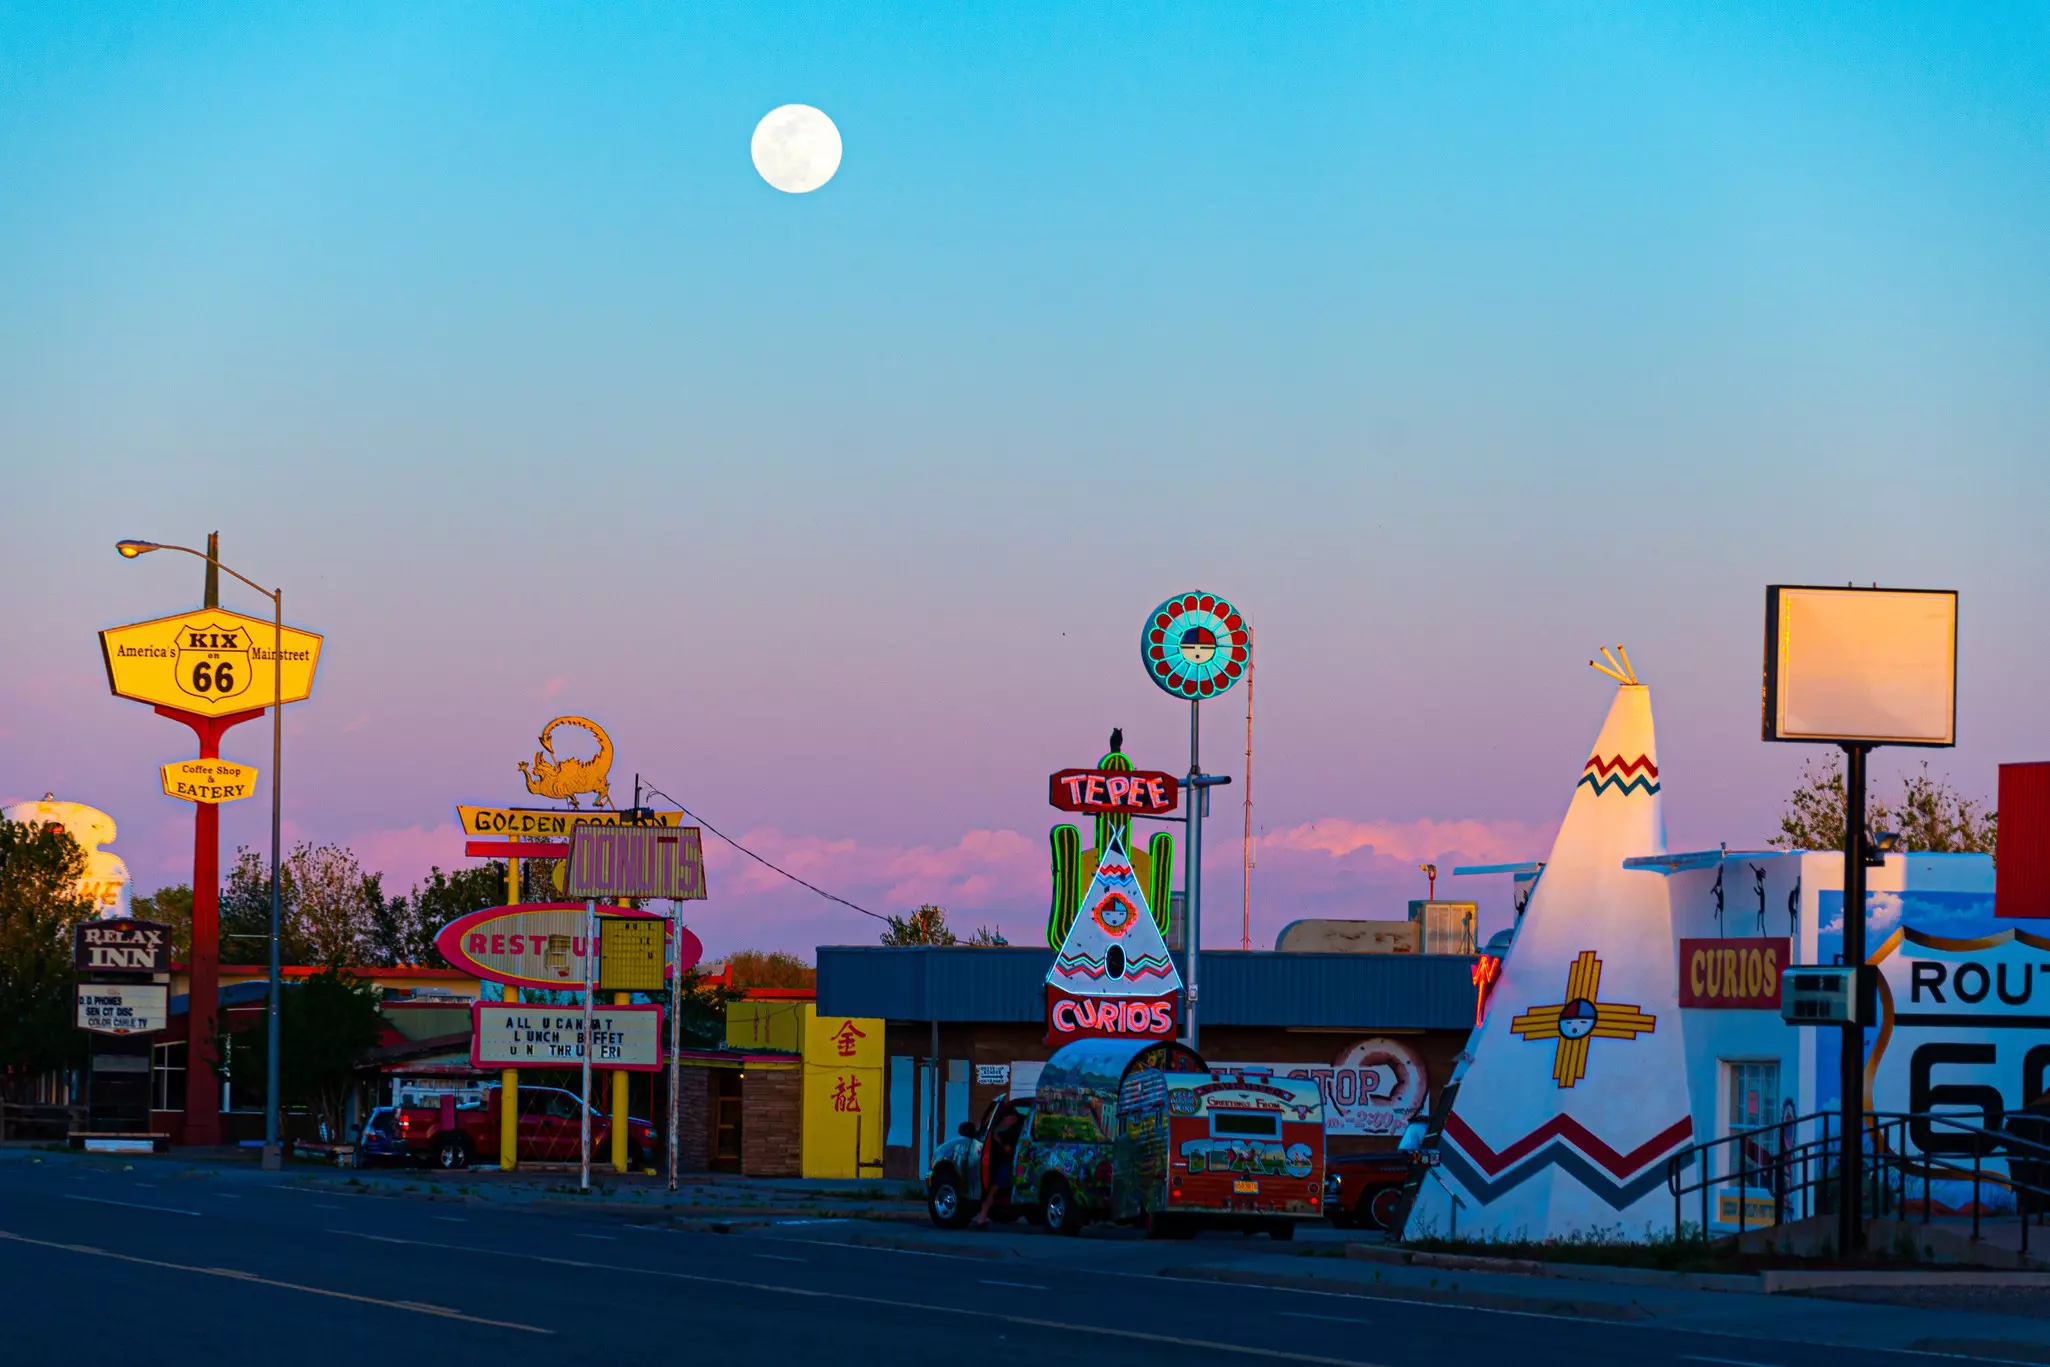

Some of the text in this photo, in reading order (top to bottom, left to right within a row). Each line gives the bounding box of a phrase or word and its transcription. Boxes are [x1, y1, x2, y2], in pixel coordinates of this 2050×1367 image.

[117, 644, 176, 658] America's
[189, 633, 238, 649] KIX
[193, 661, 234, 692] 66
[182, 765, 241, 777] Coffee Shop
[208, 775, 215, 783] &
[178, 782, 245, 799] EATERY
[1061, 773, 1169, 809] TEPEE
[475, 811, 565, 832] GOLDEN
[576, 833, 698, 891] DONUTS
[84, 928, 163, 949] RELAX
[88, 947, 159, 968] INN
[1690, 947, 1777, 998] CURIOS
[1911, 961, 2050, 1006] ROU
[117, 1007, 133, 1016] DISC
[1052, 998, 1173, 1033] CURIOS
[138, 1018, 147, 1028] TV
[577, 1033, 624, 1045] BFFET
[601, 1046, 621, 1059] FRI
[1255, 1097, 1281, 1109] FROM
[1910, 1042, 2050, 1158] 6
[1179, 1138, 1312, 1180] TEXAS
